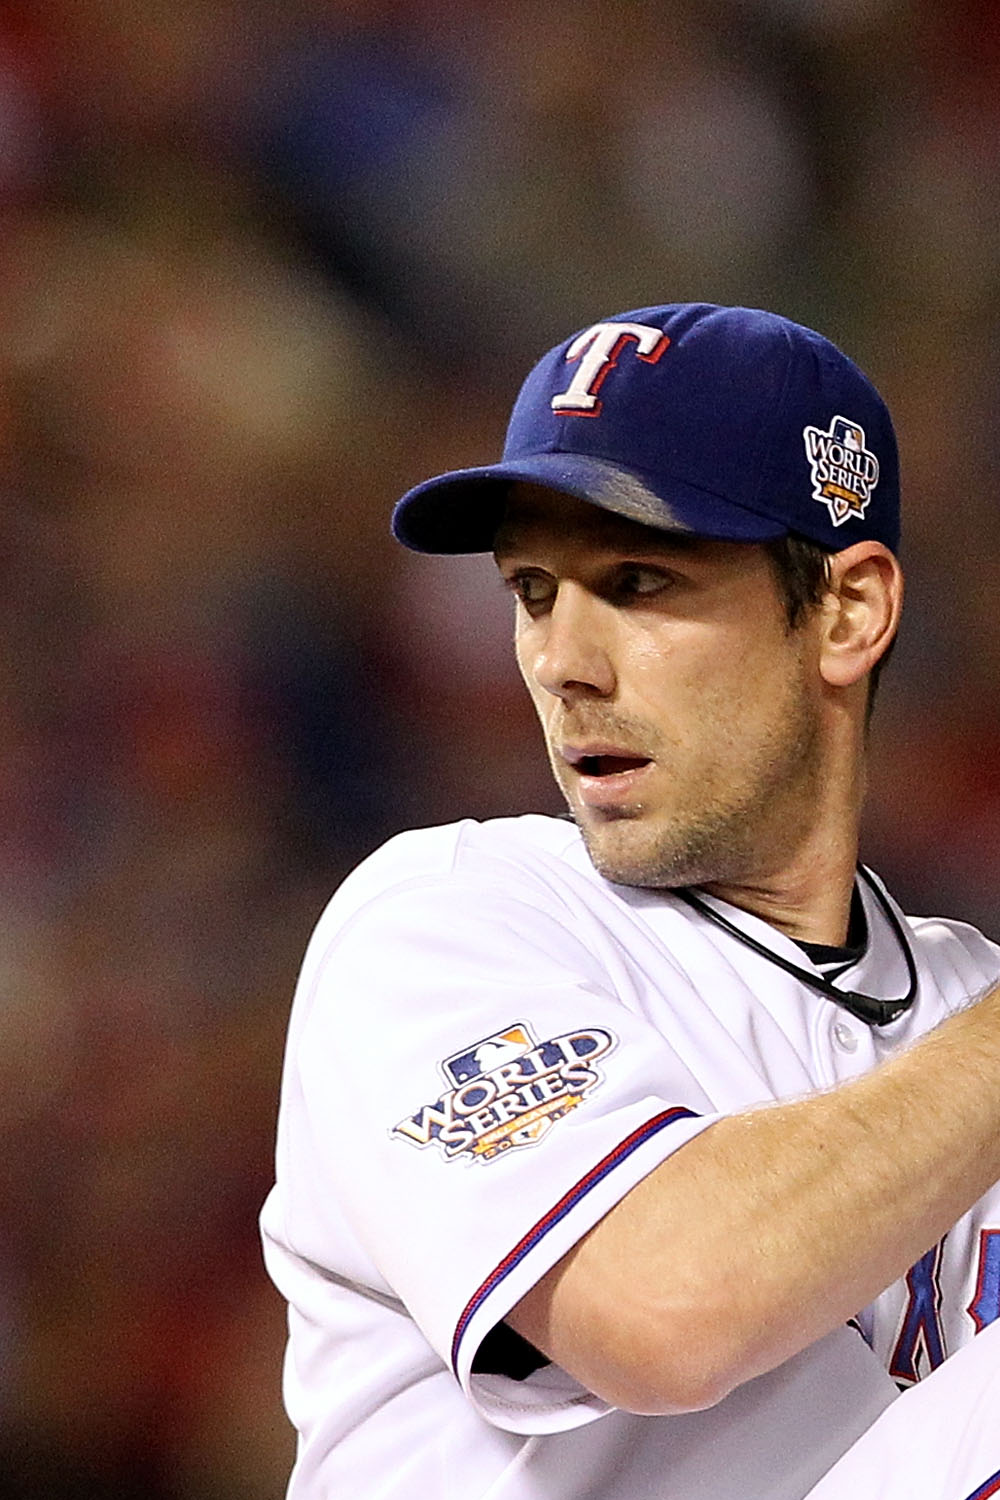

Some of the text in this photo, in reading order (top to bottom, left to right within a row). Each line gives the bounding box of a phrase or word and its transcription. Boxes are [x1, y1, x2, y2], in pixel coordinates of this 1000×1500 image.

[551, 320, 671, 418] T
[809, 431, 877, 483] WORLD
[817, 459, 869, 499] SERIES
[392, 1028, 612, 1144] WORLD
[439, 1061, 599, 1157] SERIES
